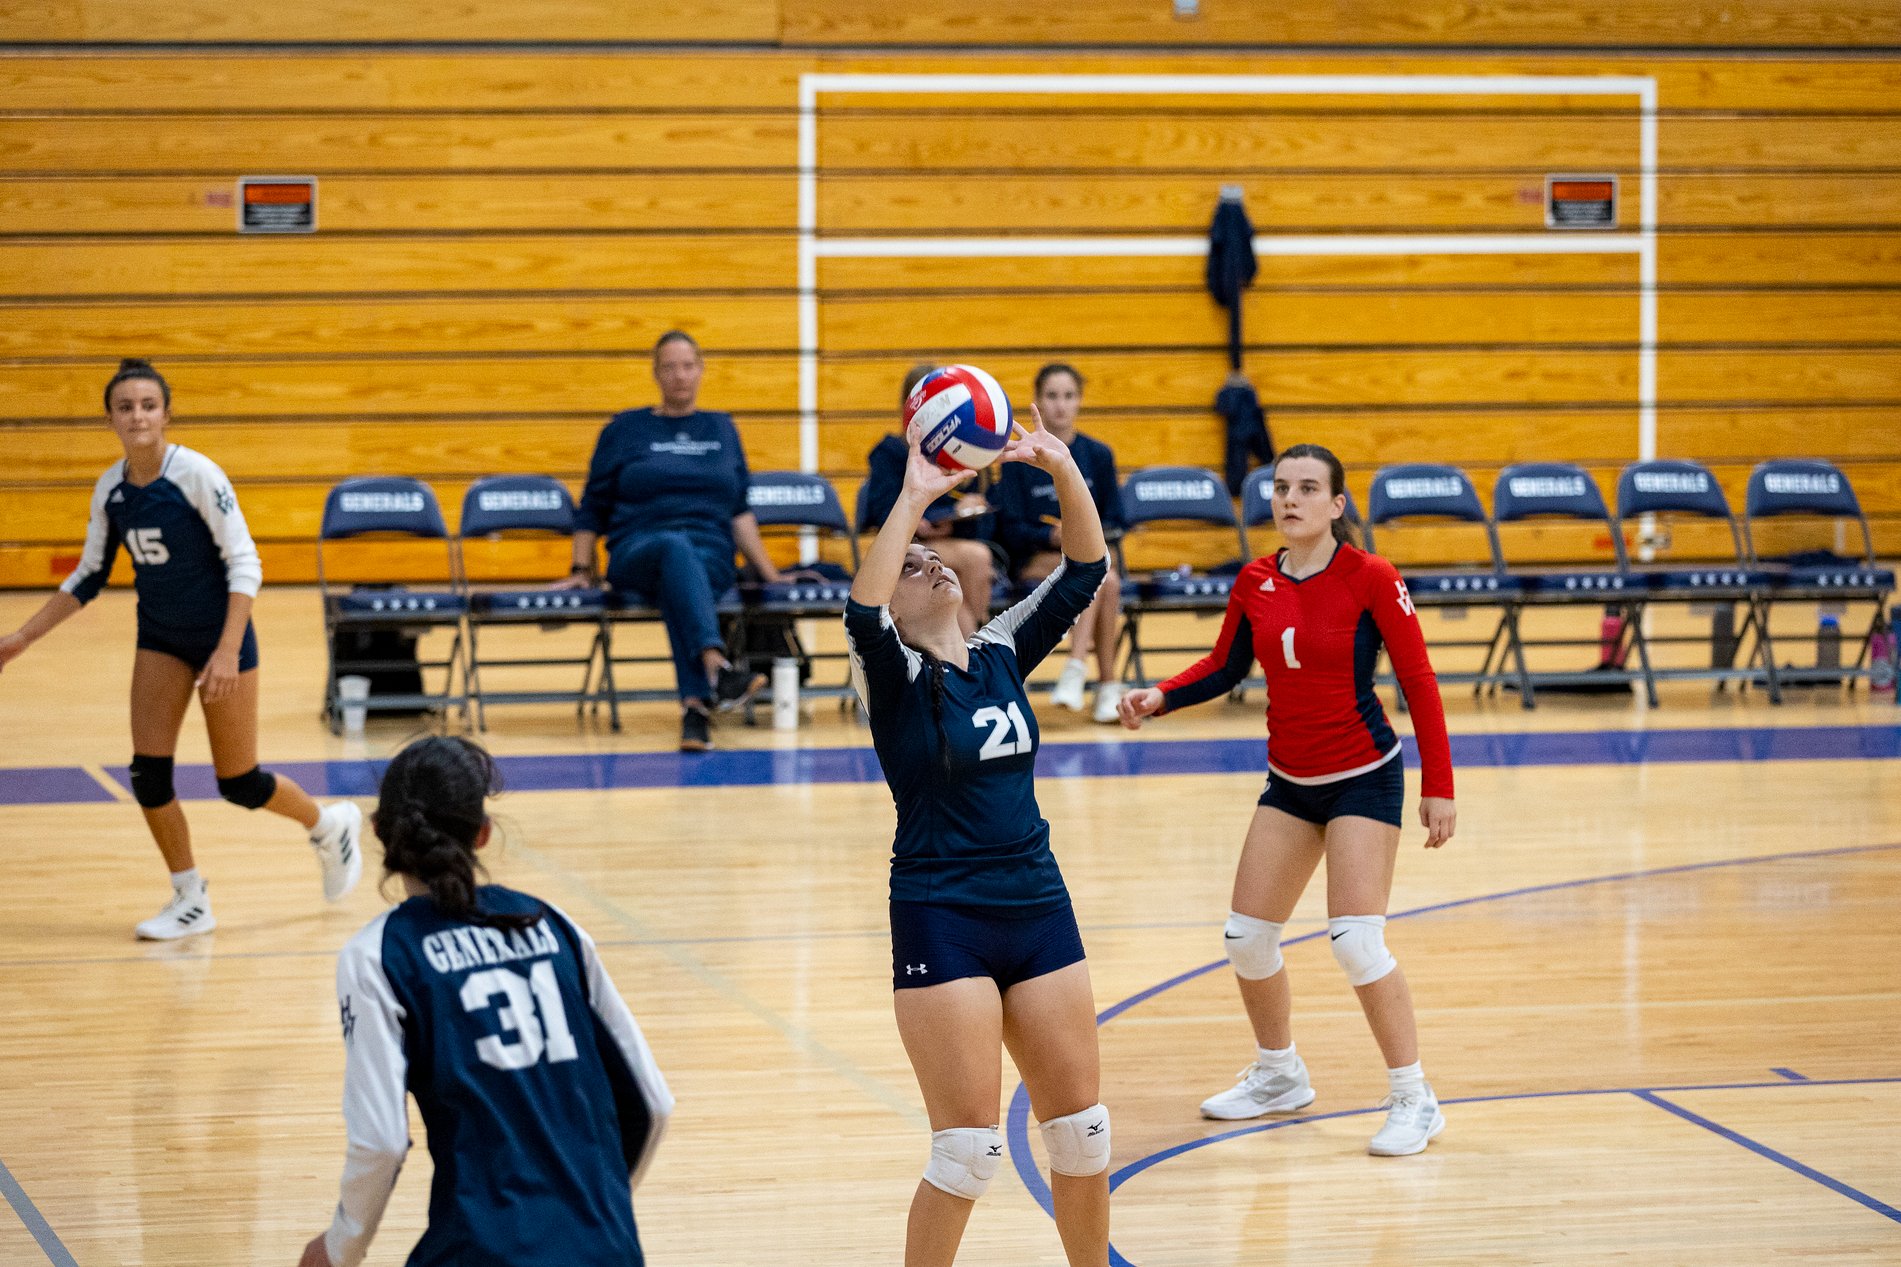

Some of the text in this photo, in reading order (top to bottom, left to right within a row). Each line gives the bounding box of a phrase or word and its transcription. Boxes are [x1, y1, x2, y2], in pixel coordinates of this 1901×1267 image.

[126, 527, 171, 565] 15
[1281, 627, 1302, 669] 1
[972, 701, 1032, 761] 21
[459, 959, 578, 1070] 31
